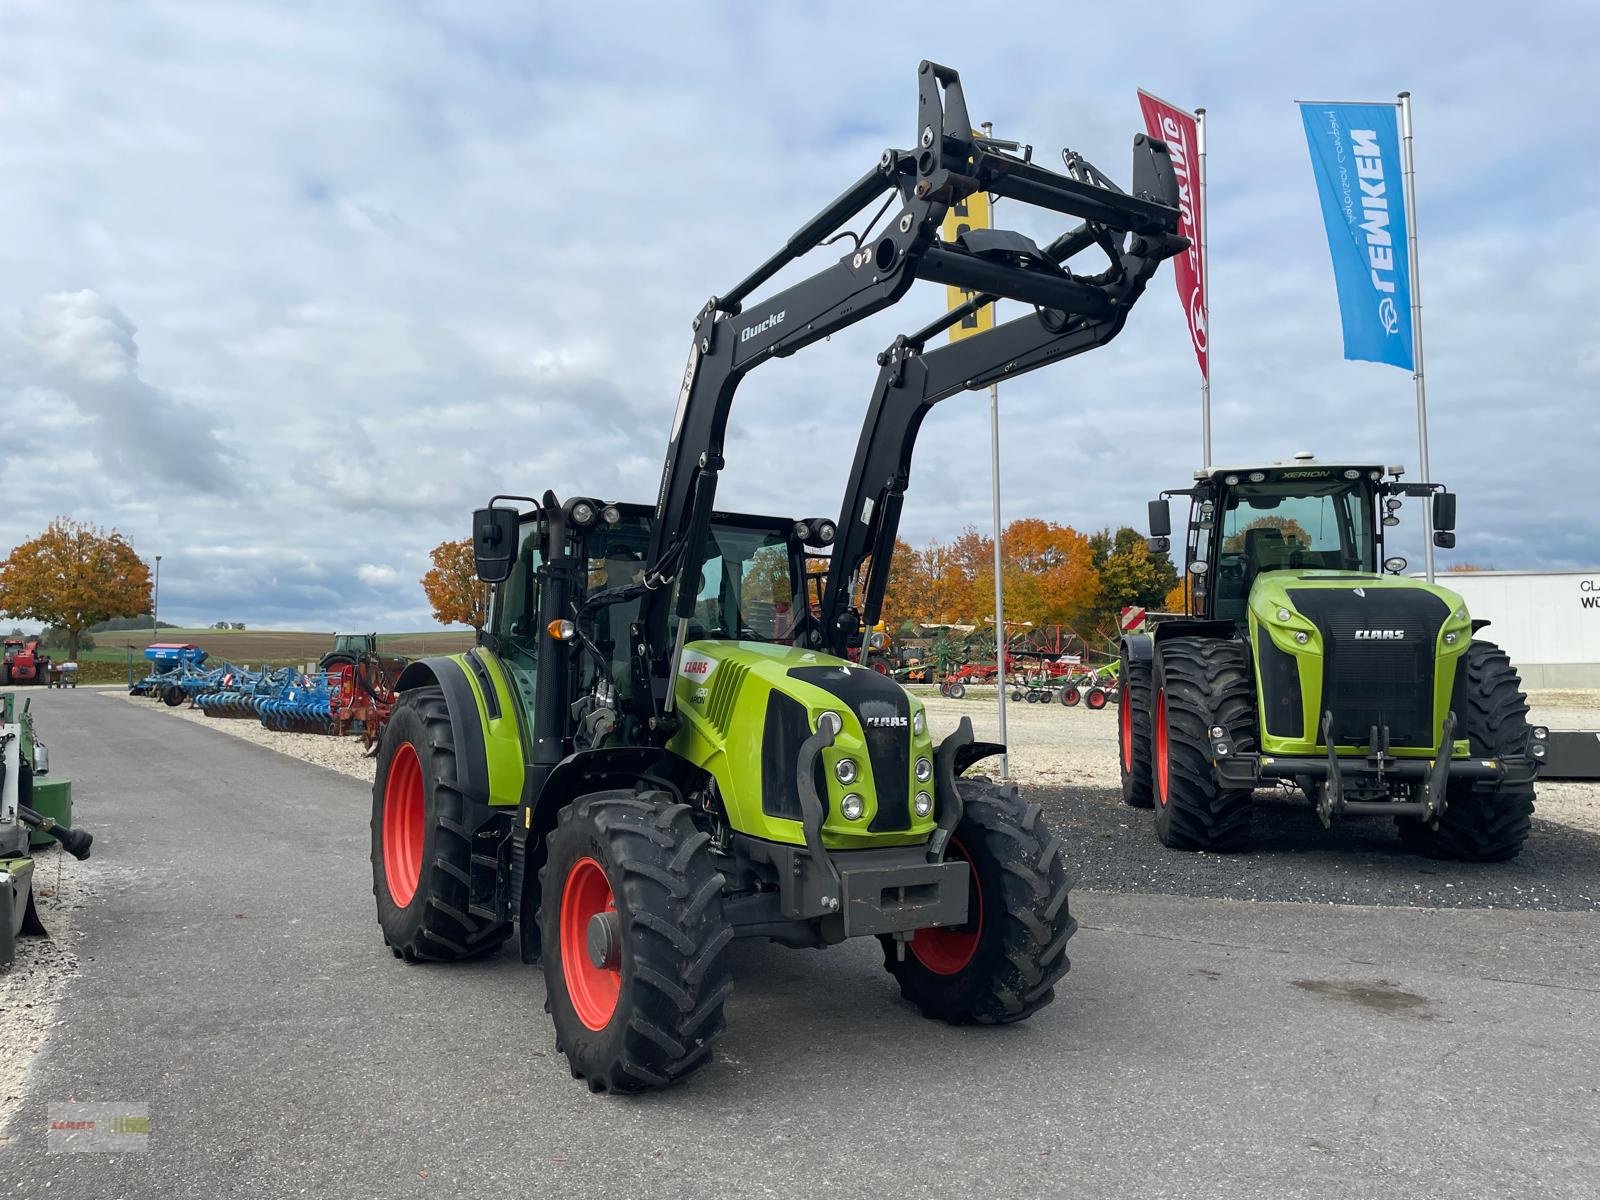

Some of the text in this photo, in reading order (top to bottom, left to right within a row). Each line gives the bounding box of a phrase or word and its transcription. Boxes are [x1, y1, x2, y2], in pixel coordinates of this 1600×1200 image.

[741, 309, 786, 342] Quicke
[1282, 470, 1331, 479] XERION
[1580, 580, 1600, 592] CL
[1354, 630, 1405, 640] CLAAS
[683, 661, 708, 674] CLAAS
[866, 716, 908, 727] CLAAS
